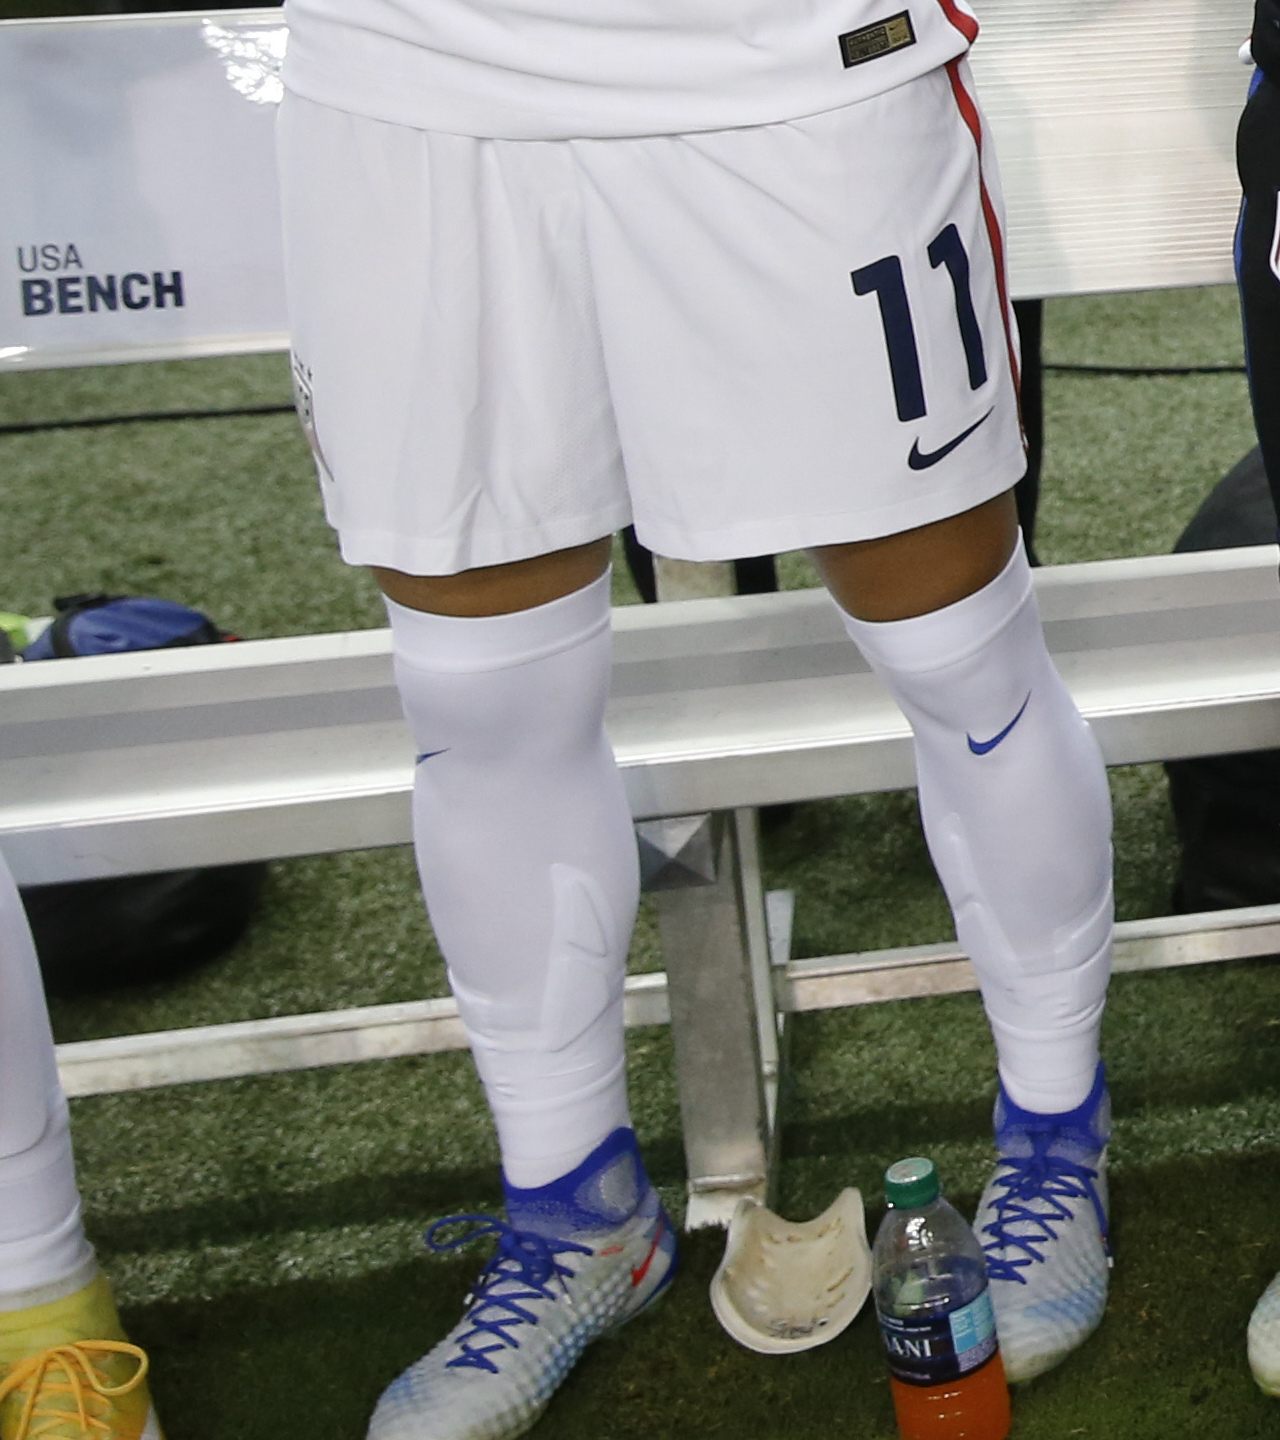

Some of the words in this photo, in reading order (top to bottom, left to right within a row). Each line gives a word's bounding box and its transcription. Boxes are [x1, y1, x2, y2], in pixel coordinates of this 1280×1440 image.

[17, 243, 83, 272] USA
[21, 271, 185, 316] BENCH
[850, 222, 988, 422] 11
